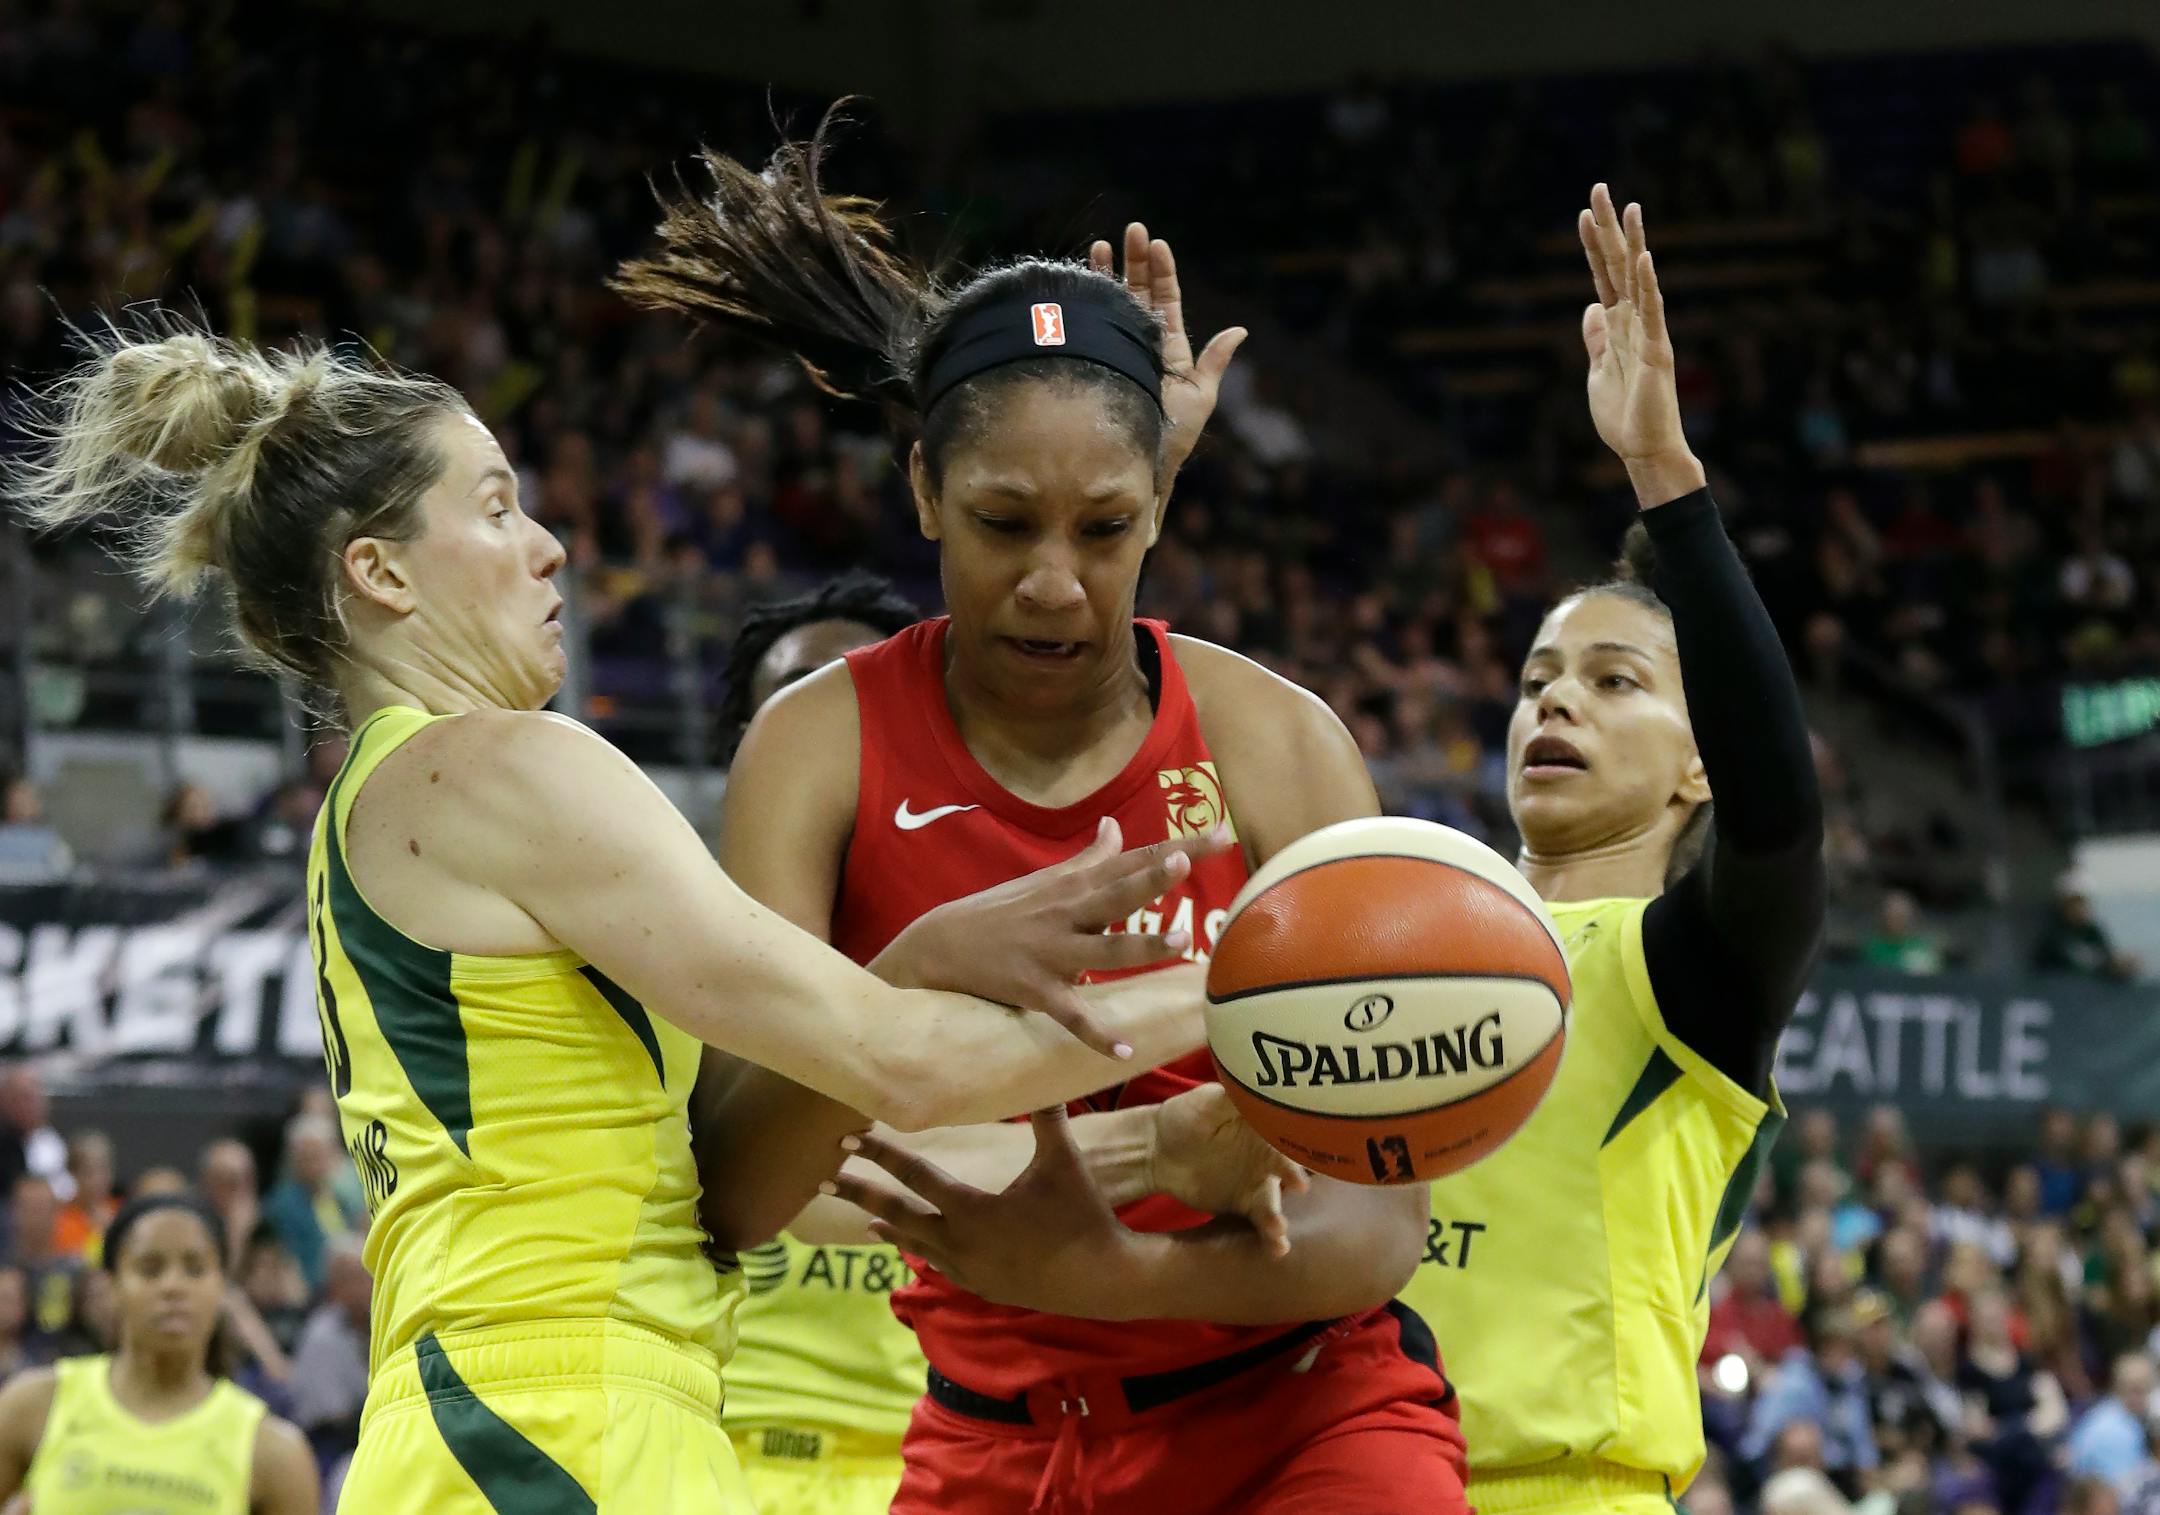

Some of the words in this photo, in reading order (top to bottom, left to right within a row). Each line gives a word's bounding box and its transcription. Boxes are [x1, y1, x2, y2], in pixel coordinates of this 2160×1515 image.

[1103, 895, 1228, 964] GAS
[0, 920, 323, 1057] KET
[1251, 1009, 1505, 1088] SPALDING
